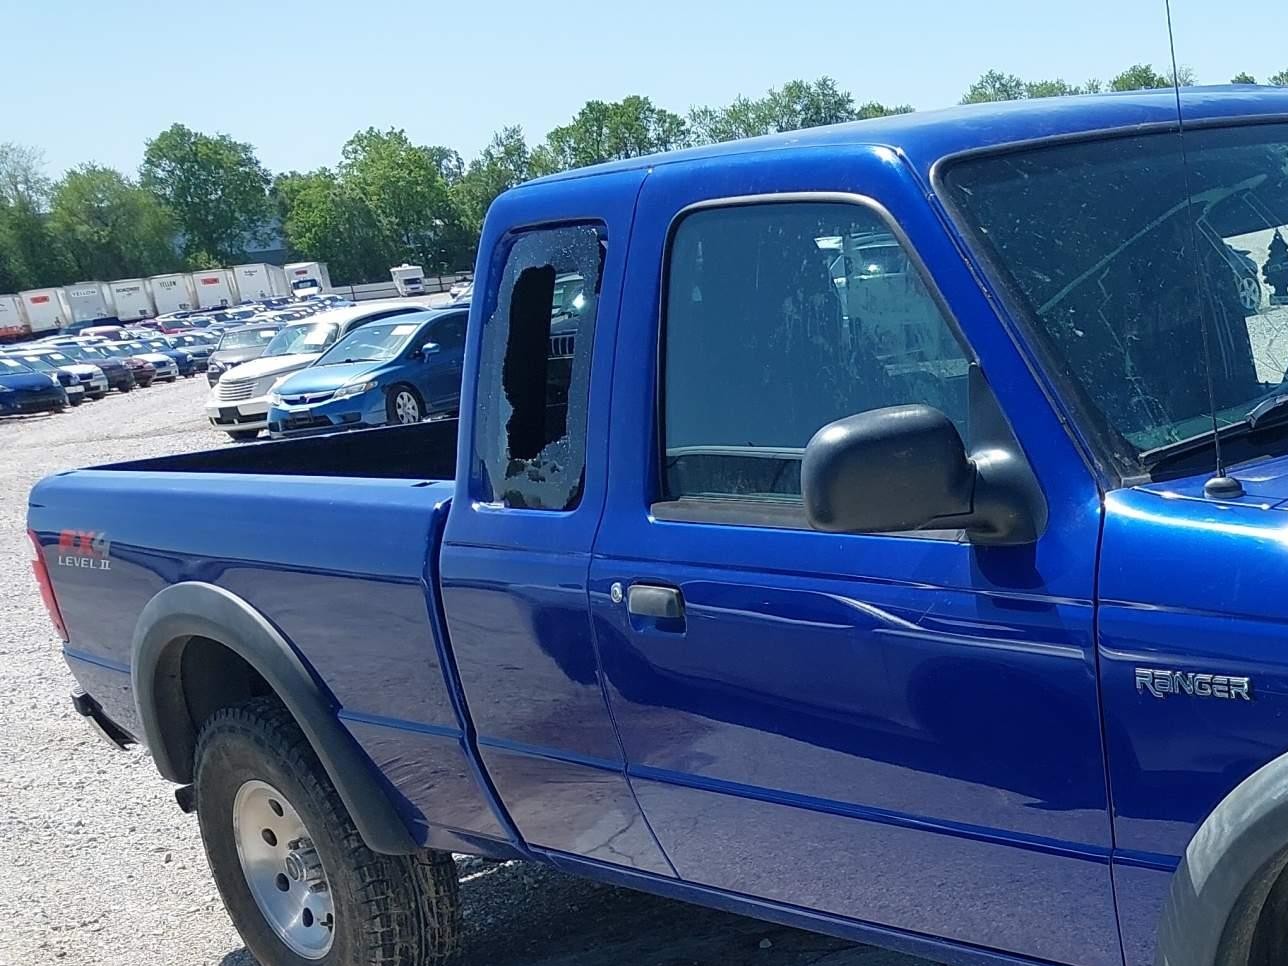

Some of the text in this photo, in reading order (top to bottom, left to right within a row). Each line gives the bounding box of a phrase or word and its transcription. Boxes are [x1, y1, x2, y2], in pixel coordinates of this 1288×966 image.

[58, 555, 112, 570] LEVEL II
[1135, 667, 1251, 701] RANGER
